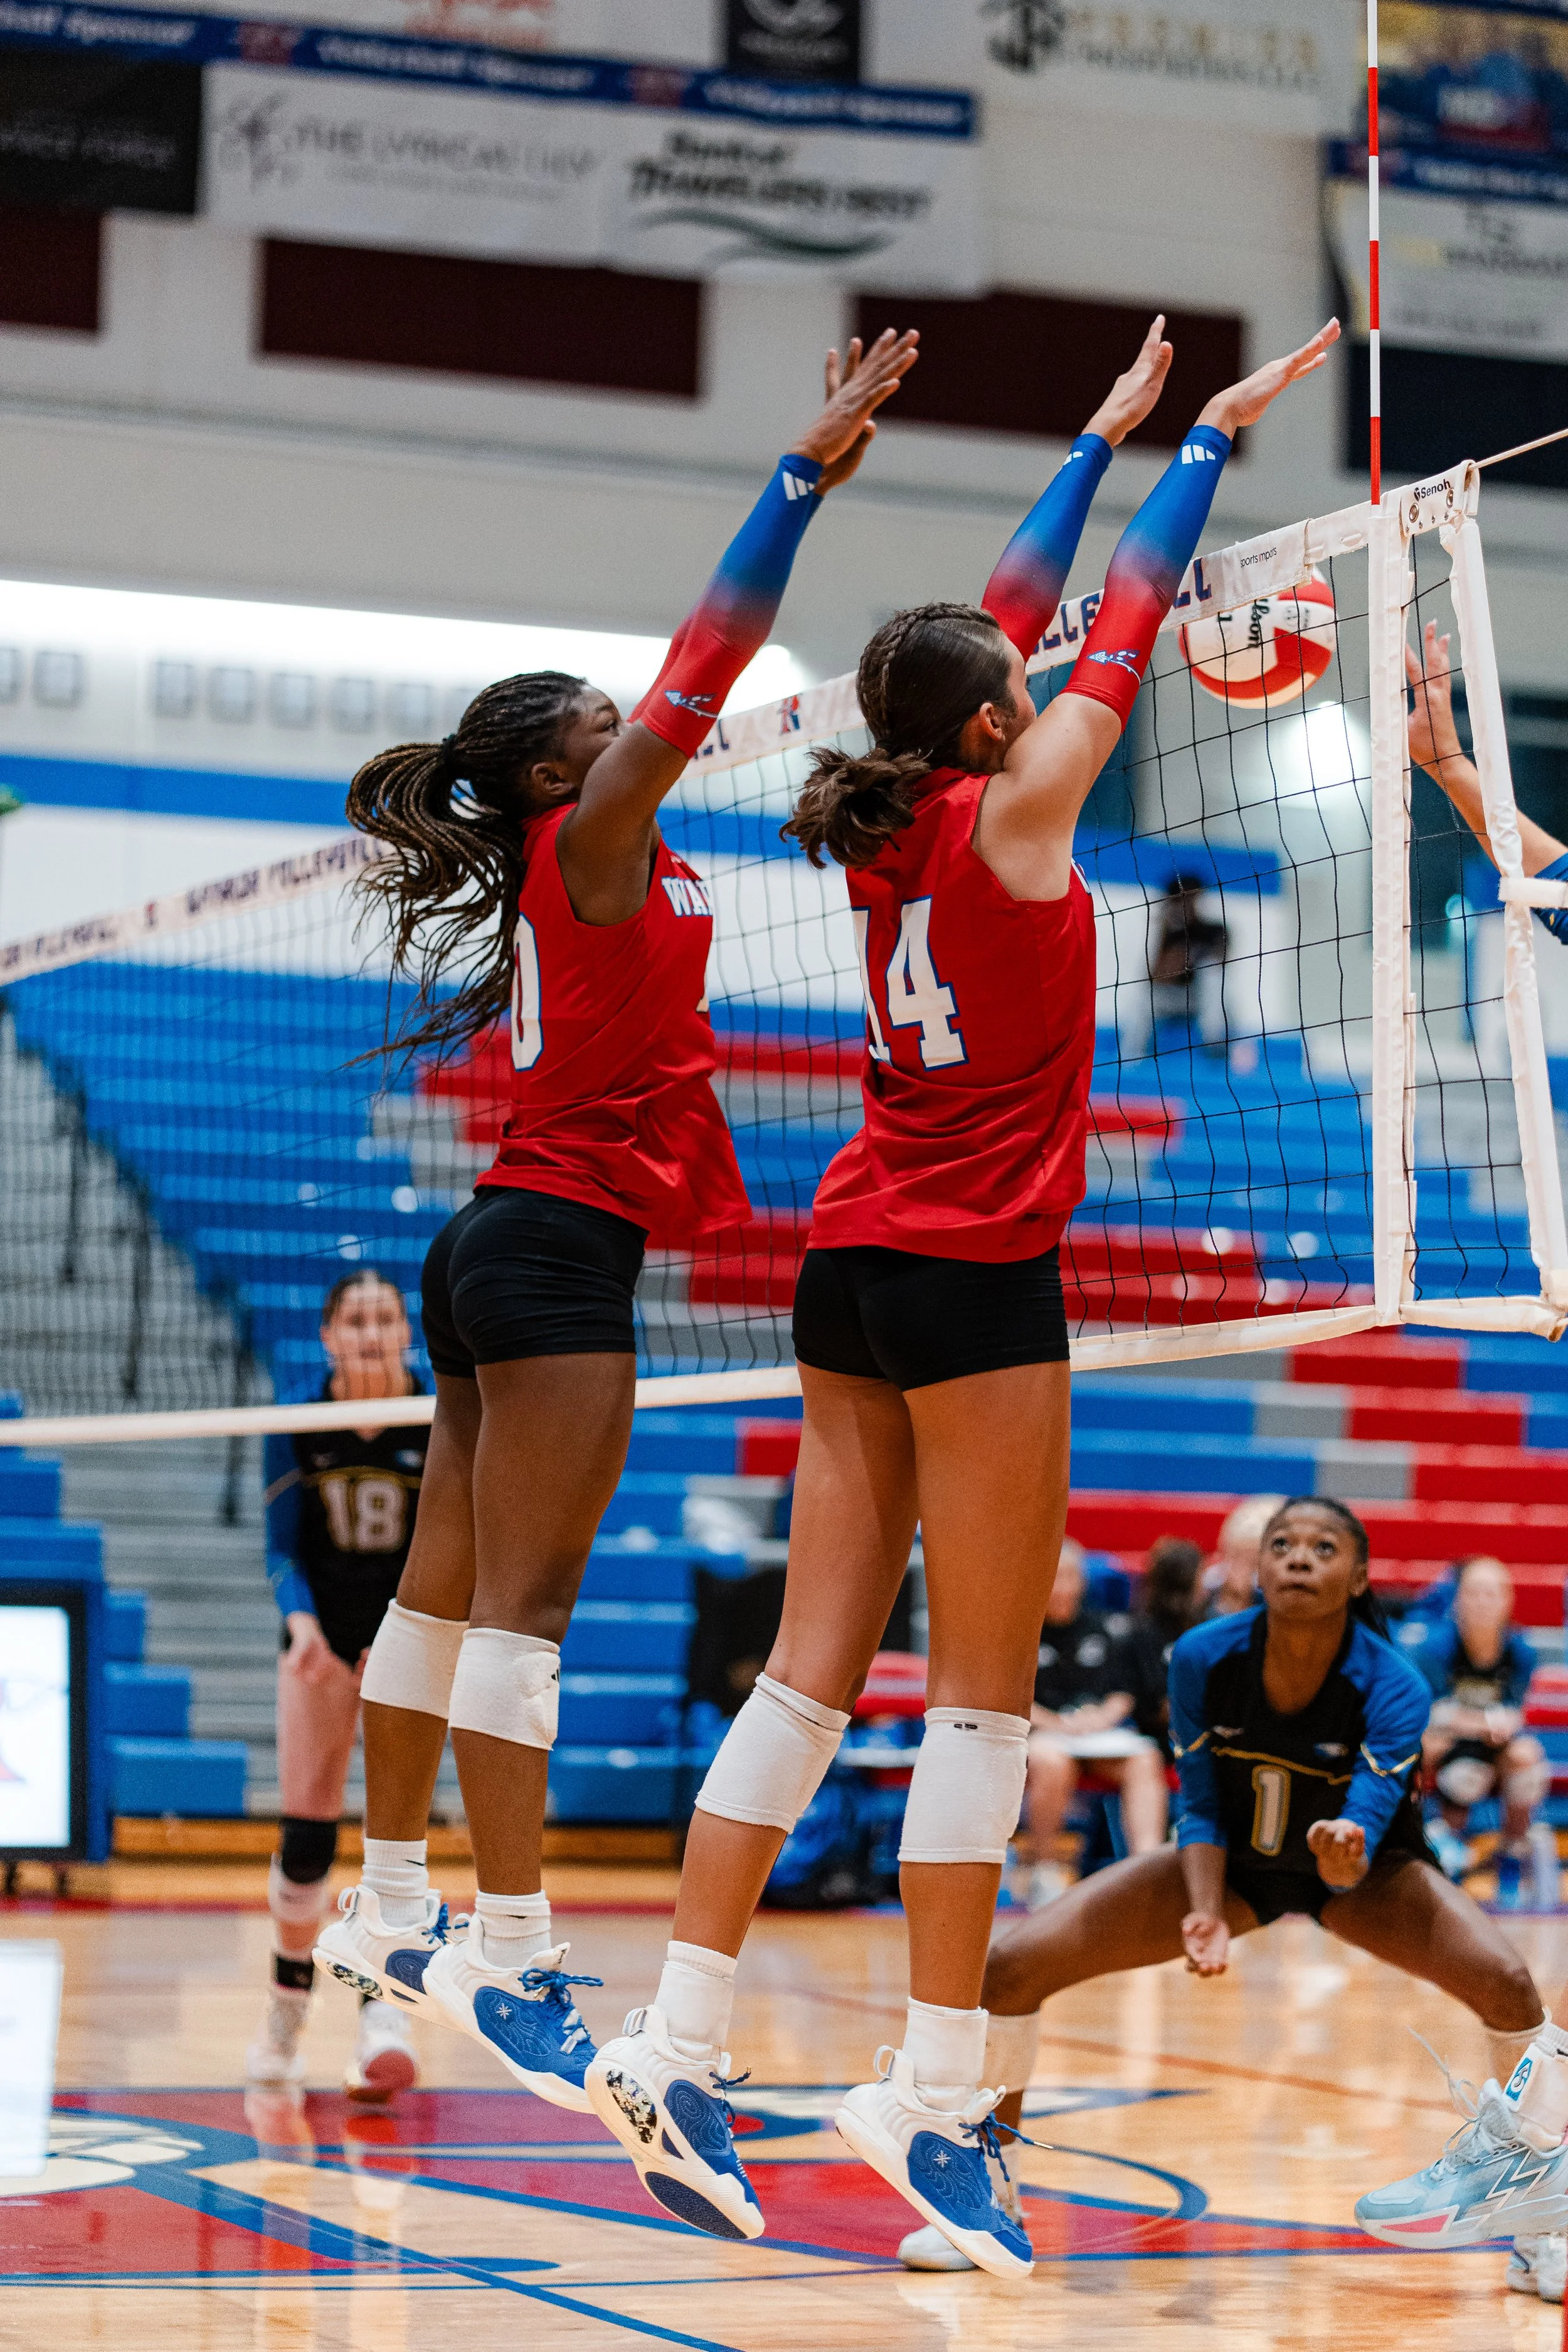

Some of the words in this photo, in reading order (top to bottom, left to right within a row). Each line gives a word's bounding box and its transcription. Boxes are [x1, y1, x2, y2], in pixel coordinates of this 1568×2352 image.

[1421, 479, 1451, 499] Senoh
[319, 1471, 408, 1555] 18
[1251, 1764, 1291, 1857] 1
